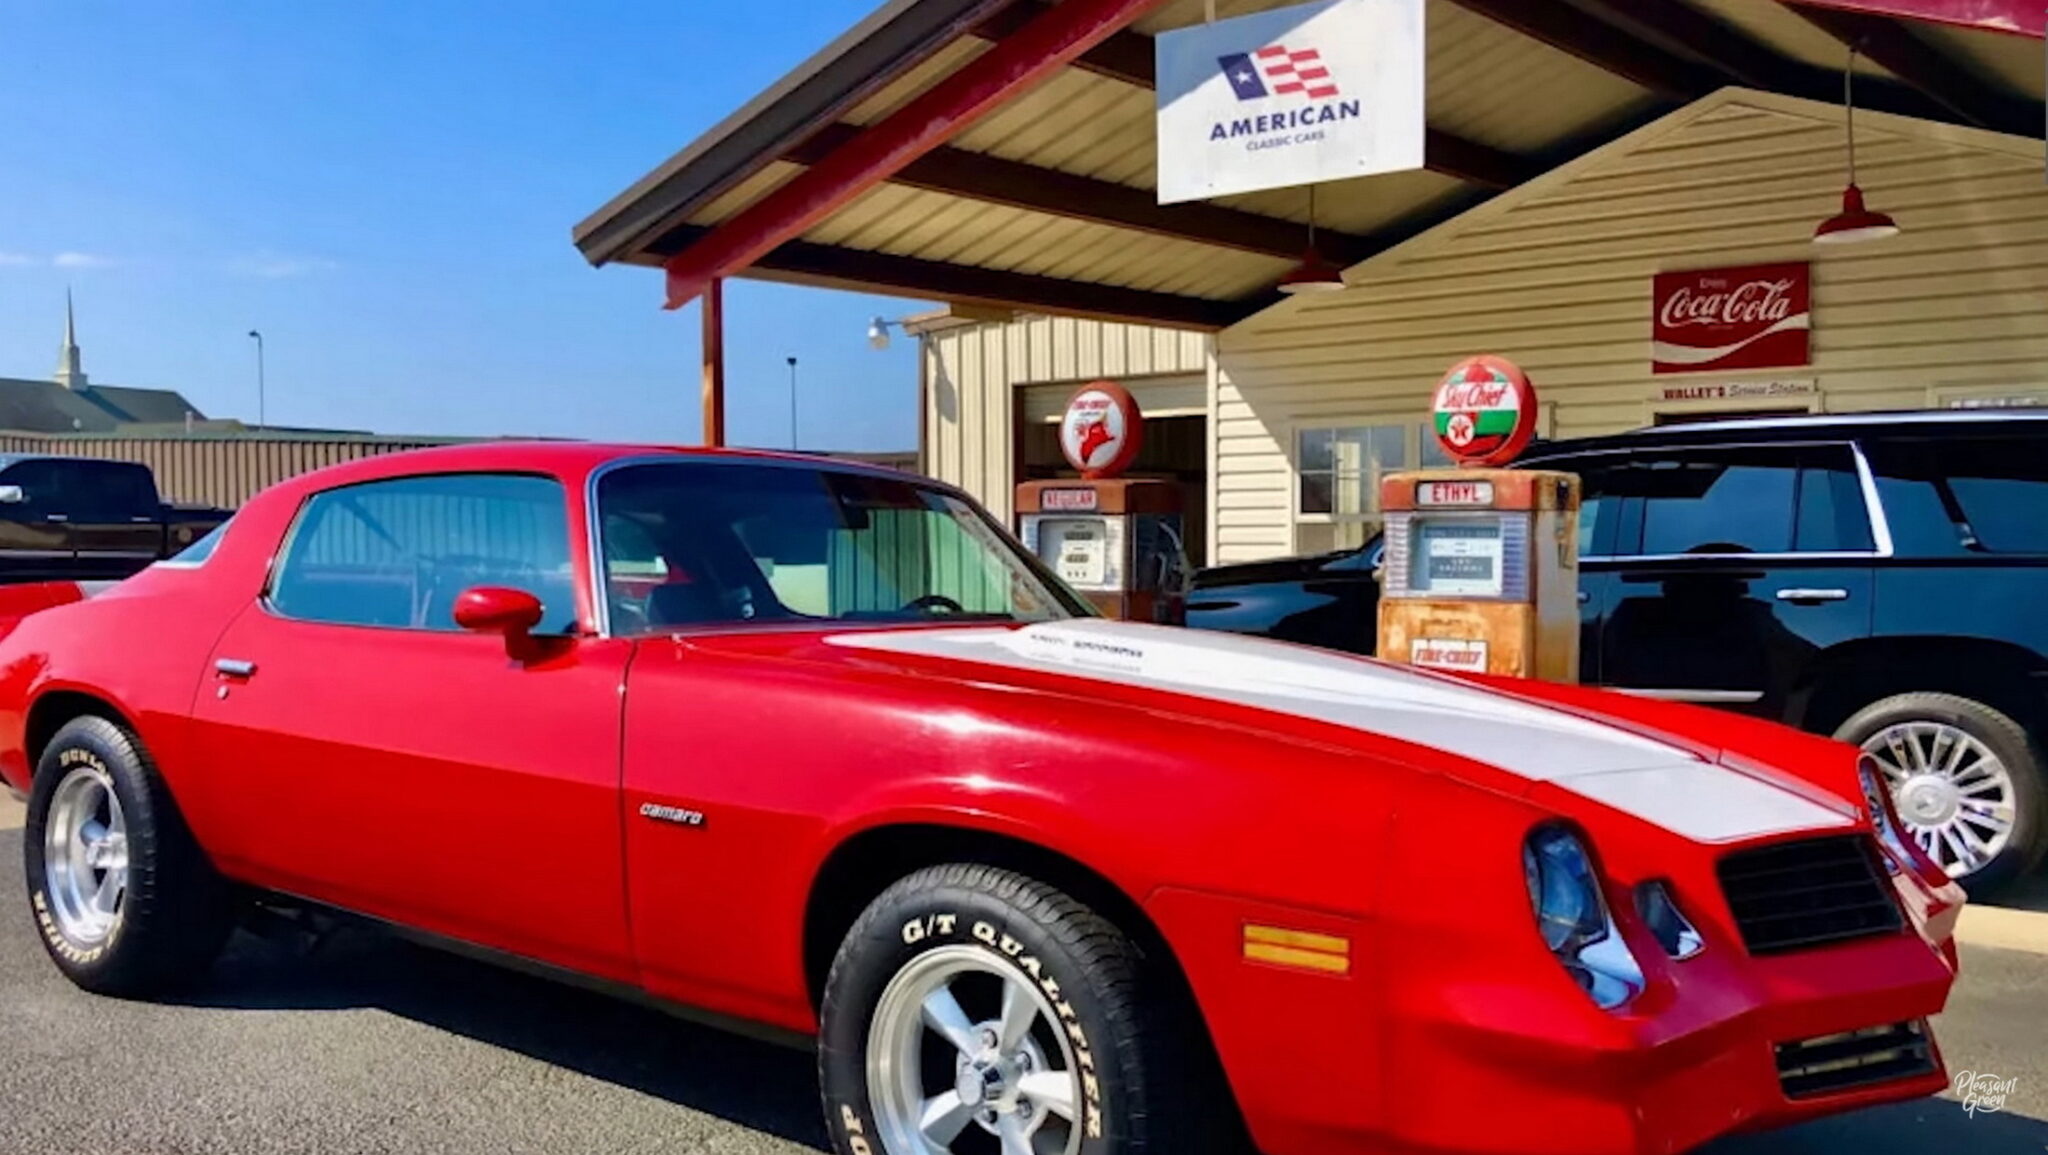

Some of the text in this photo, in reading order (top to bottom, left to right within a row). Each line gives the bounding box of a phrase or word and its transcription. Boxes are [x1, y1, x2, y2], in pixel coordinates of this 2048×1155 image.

[1210, 100, 1360, 141] AMERICAN
[1246, 130, 1325, 151] CLASSIC CARS
[1660, 278, 1796, 328] Coca-Cola
[1432, 483, 1480, 503] ETHYL
[902, 914, 1101, 1138] G/T QUALIFIER
